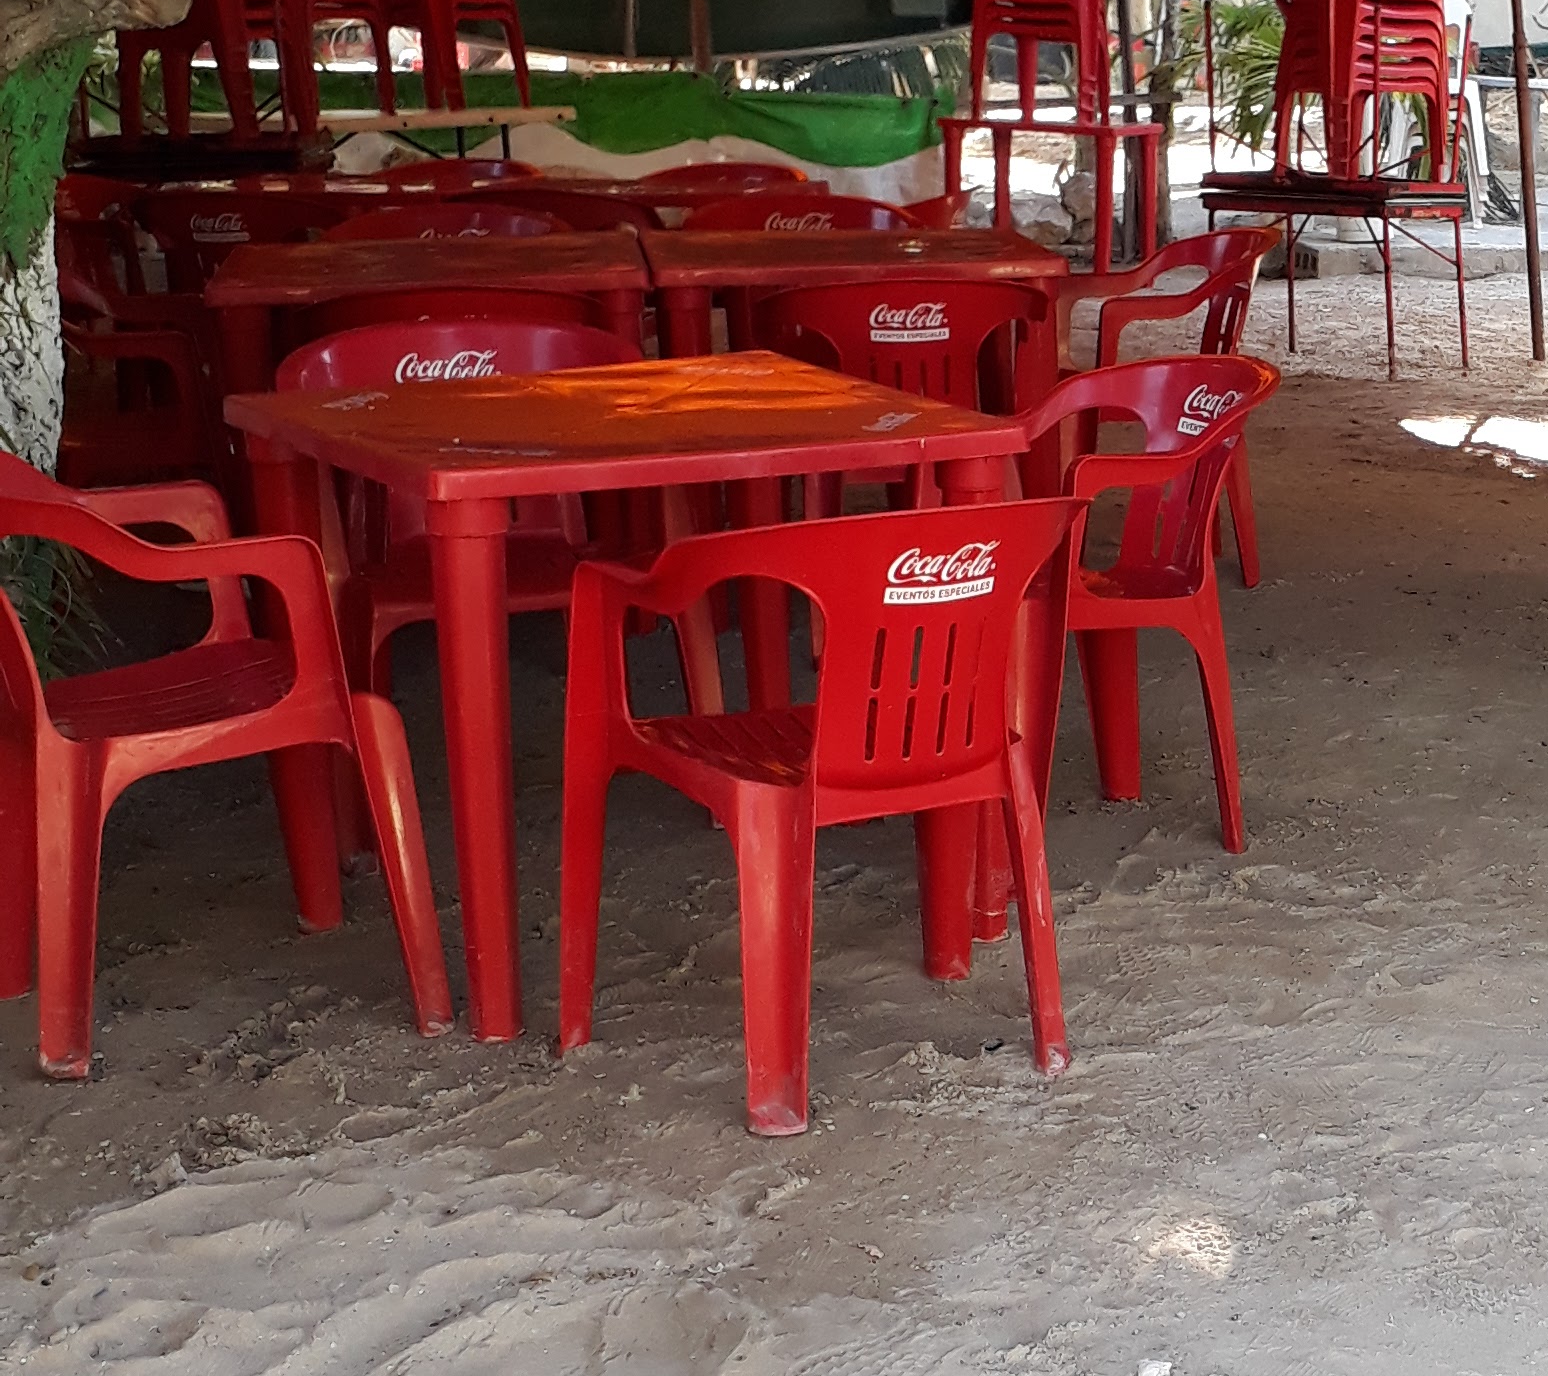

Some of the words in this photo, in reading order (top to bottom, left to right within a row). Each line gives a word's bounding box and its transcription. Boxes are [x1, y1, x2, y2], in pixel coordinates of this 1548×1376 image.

[869, 301, 949, 328] Coca-Cola
[887, 539, 1001, 584] Coca-Cola
[889, 590, 936, 600] EVENTOS
[938, 580, 991, 599] ESPECIALES
